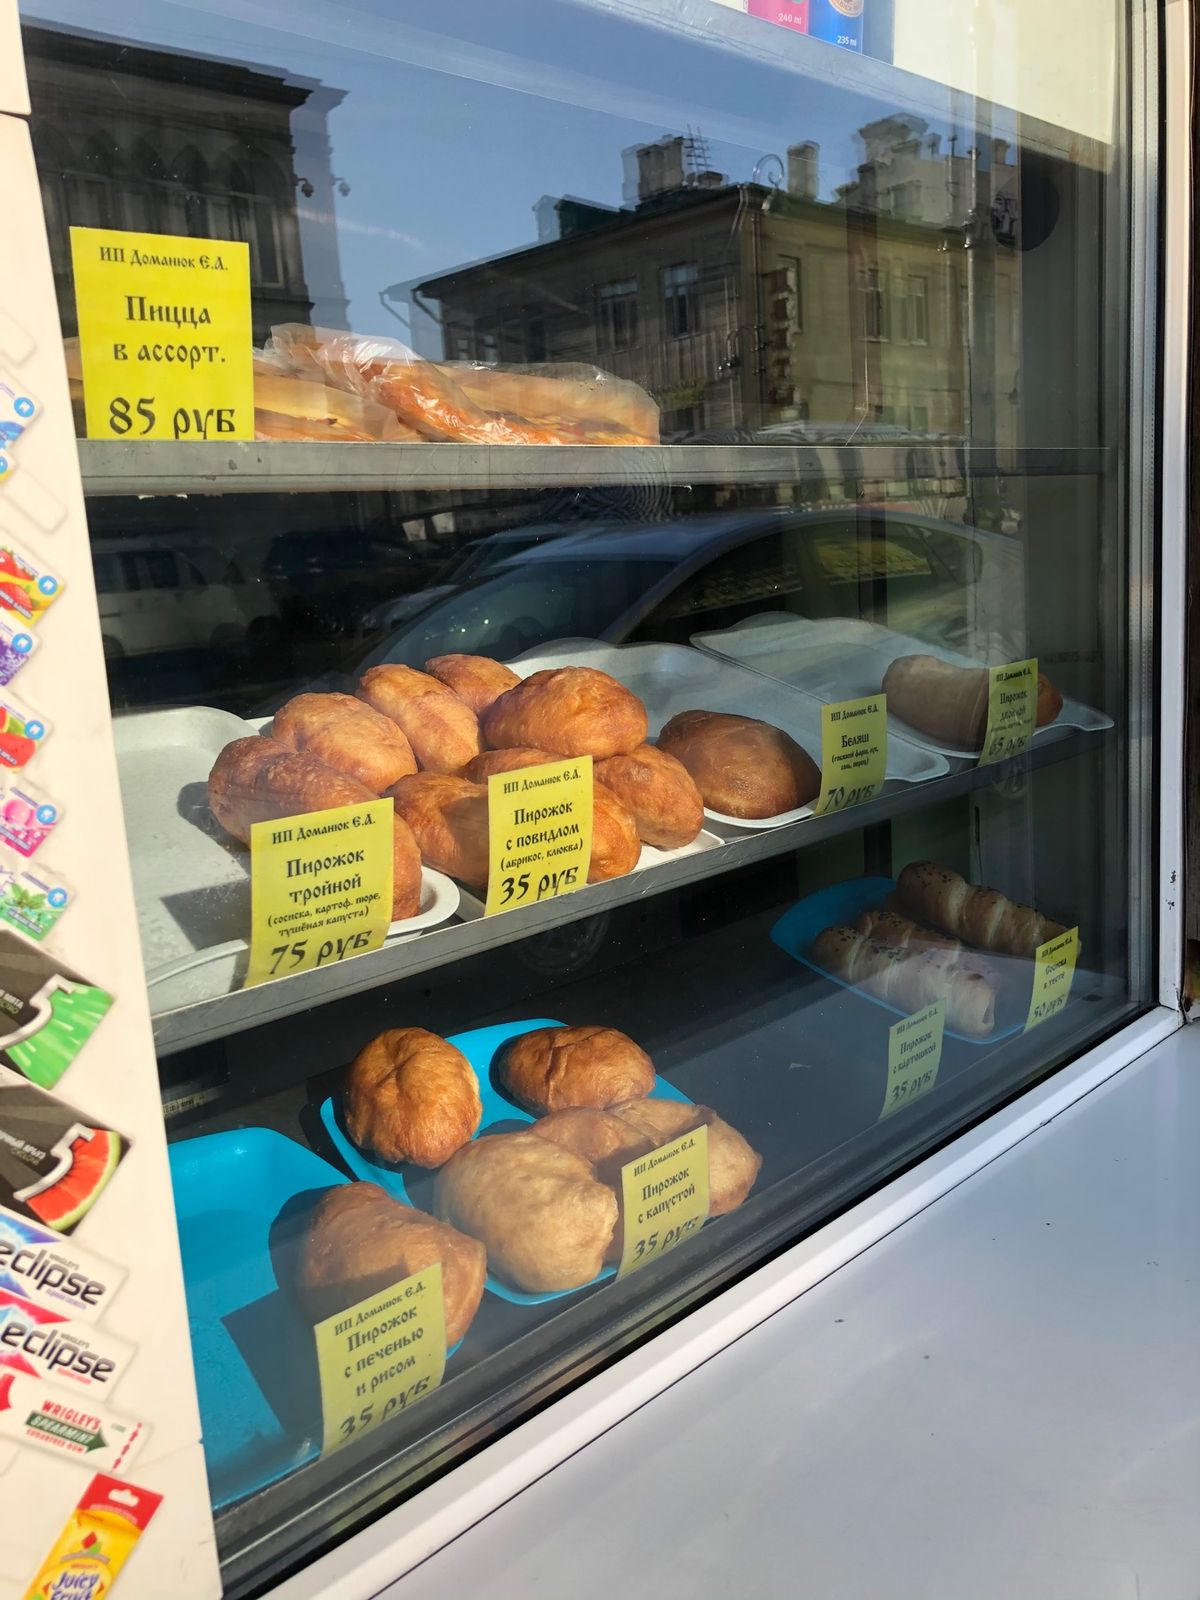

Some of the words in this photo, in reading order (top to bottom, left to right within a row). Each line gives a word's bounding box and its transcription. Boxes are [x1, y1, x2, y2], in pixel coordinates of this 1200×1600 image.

[837, 35, 849, 45] 235
[99, 246, 125, 263] ИП
[130, 249, 196, 269] Доманюк
[125, 295, 212, 329] Пицца
[113, 343, 129, 361] в
[137, 344, 226, 370] ассорт.
[109, 397, 156, 435] 85
[173, 408, 236, 440] руб
[831, 712, 841, 721] ИП
[841, 733, 870, 748] Беляш
[503, 781, 519, 794] ИП
[521, 775, 561, 791] Доманюк
[824, 786, 845, 811] 70
[514, 802, 573, 826] Пирожок
[272, 829, 293, 845] ИП
[296, 820, 350, 842] Доманюк
[506, 839, 513, 850] с
[516, 823, 579, 848] повидлом
[286, 849, 365, 879] Пирожок
[500, 852, 544, 872] (абрикос,
[546, 837, 583, 858] клюква)
[289, 873, 362, 906] тройной
[500, 872, 531, 905] 35
[537, 866, 579, 901] руб
[278, 919, 324, 938] тушёная
[326, 905, 369, 926] капуста)
[269, 939, 309, 975] 75
[316, 930, 373, 967] руб
[900, 1031, 932, 1055] Пирожок
[890, 1081, 909, 1105] 35
[13, 1122, 96, 1202] 5
[634, 1162, 646, 1177] ИП
[648, 1147, 680, 1171] Доманюк
[642, 1168, 689, 1201] Пирожок
[638, 1213, 643, 1224] с
[646, 1183, 695, 1219] капустой
[632, 1232, 659, 1263] 35
[661, 1215, 699, 1250] руб
[0, 1239, 106, 1306] eclipse
[334, 1318, 353, 1337] ИП
[355, 1295, 403, 1326] Доманюк
[347, 1306, 418, 1352] Пирожок
[1, 1321, 116, 1383] eclipse
[344, 1366, 352, 1378] с
[356, 1327, 424, 1372] печенью
[356, 1383, 366, 1397] и
[370, 1355, 416, 1392] рисом
[42, 1400, 102, 1432] WRIGLEY'S
[339, 1403, 375, 1441] 35
[381, 1376, 431, 1420] руб
[30, 1415, 95, 1444] SPEARMINT
[52, 1571, 100, 1592] Juicy
